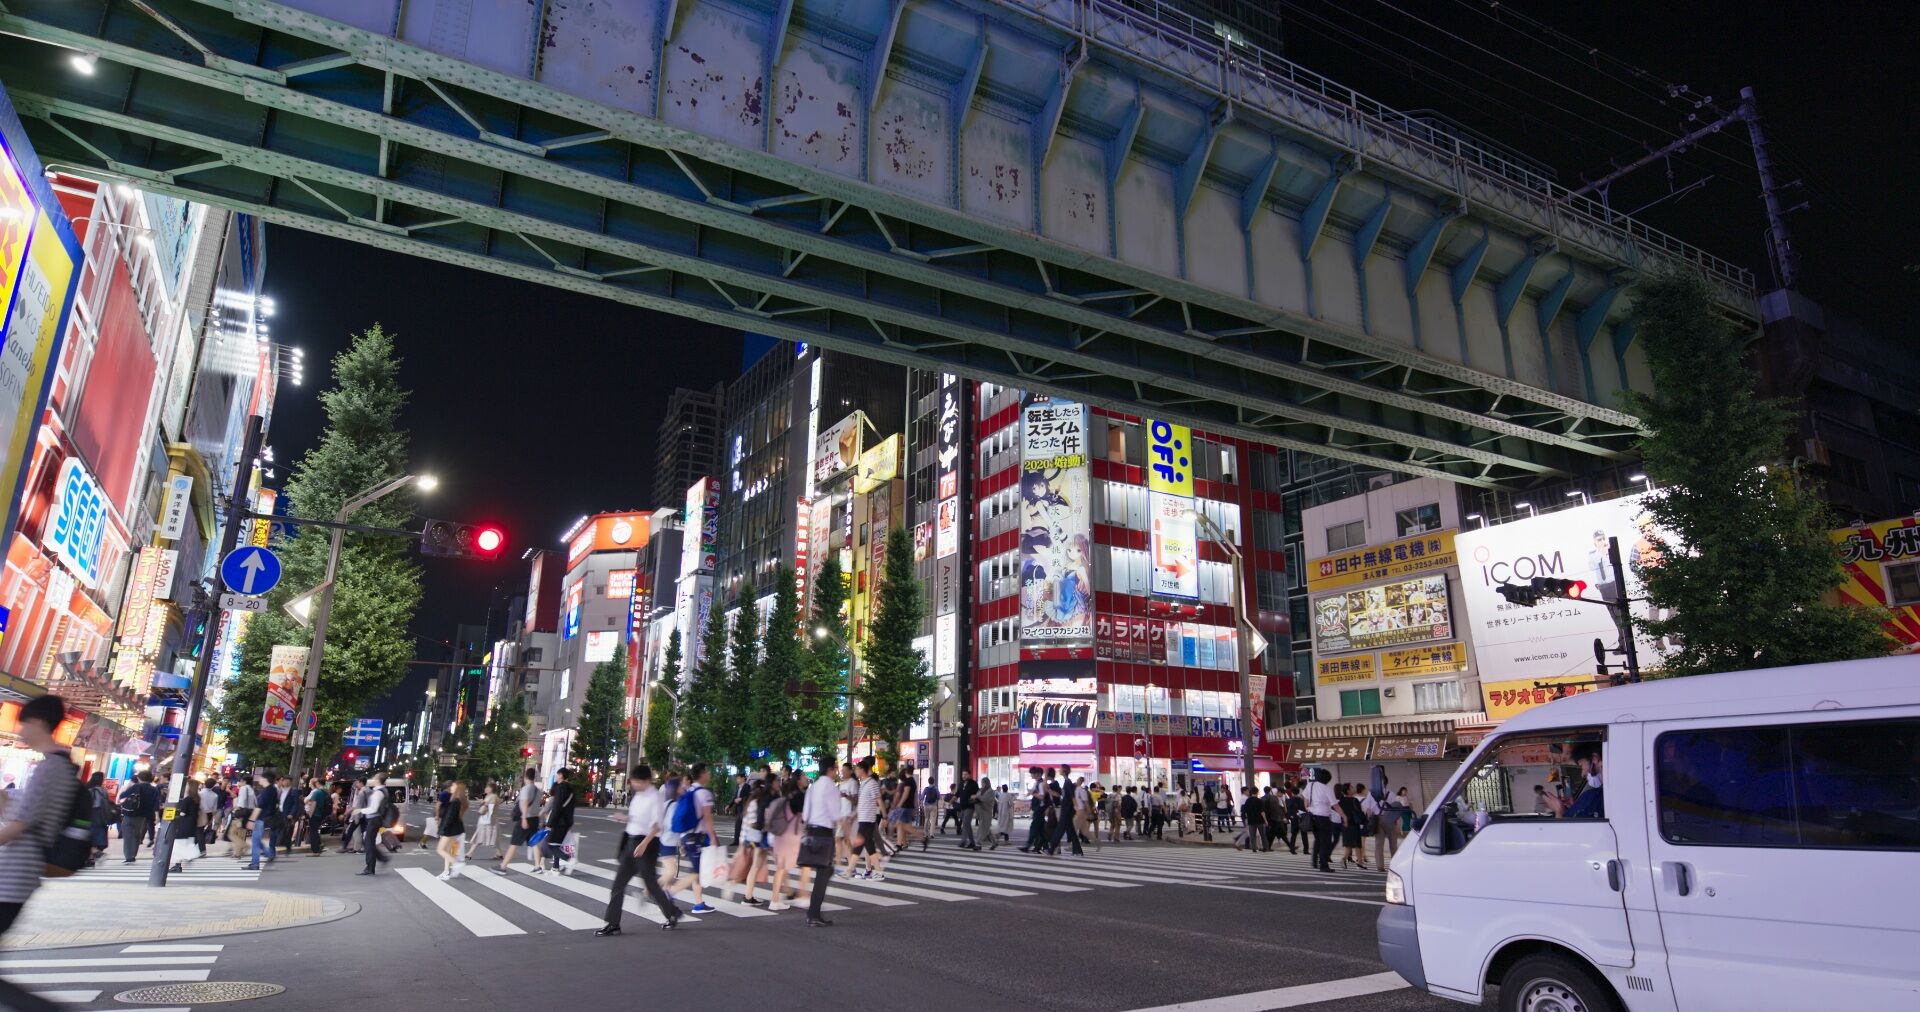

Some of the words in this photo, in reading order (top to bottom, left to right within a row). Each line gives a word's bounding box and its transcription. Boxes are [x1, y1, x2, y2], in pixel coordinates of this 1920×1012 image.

[1027, 407, 1080, 423] 転生したら
[1027, 421, 1080, 436] スライム
[1028, 436, 1080, 454] だった件
[53, 464, 107, 581] SEGA
[1097, 618, 1163, 641] カラオケ
[1514, 651, 1568, 663] www.icom.co.jp
